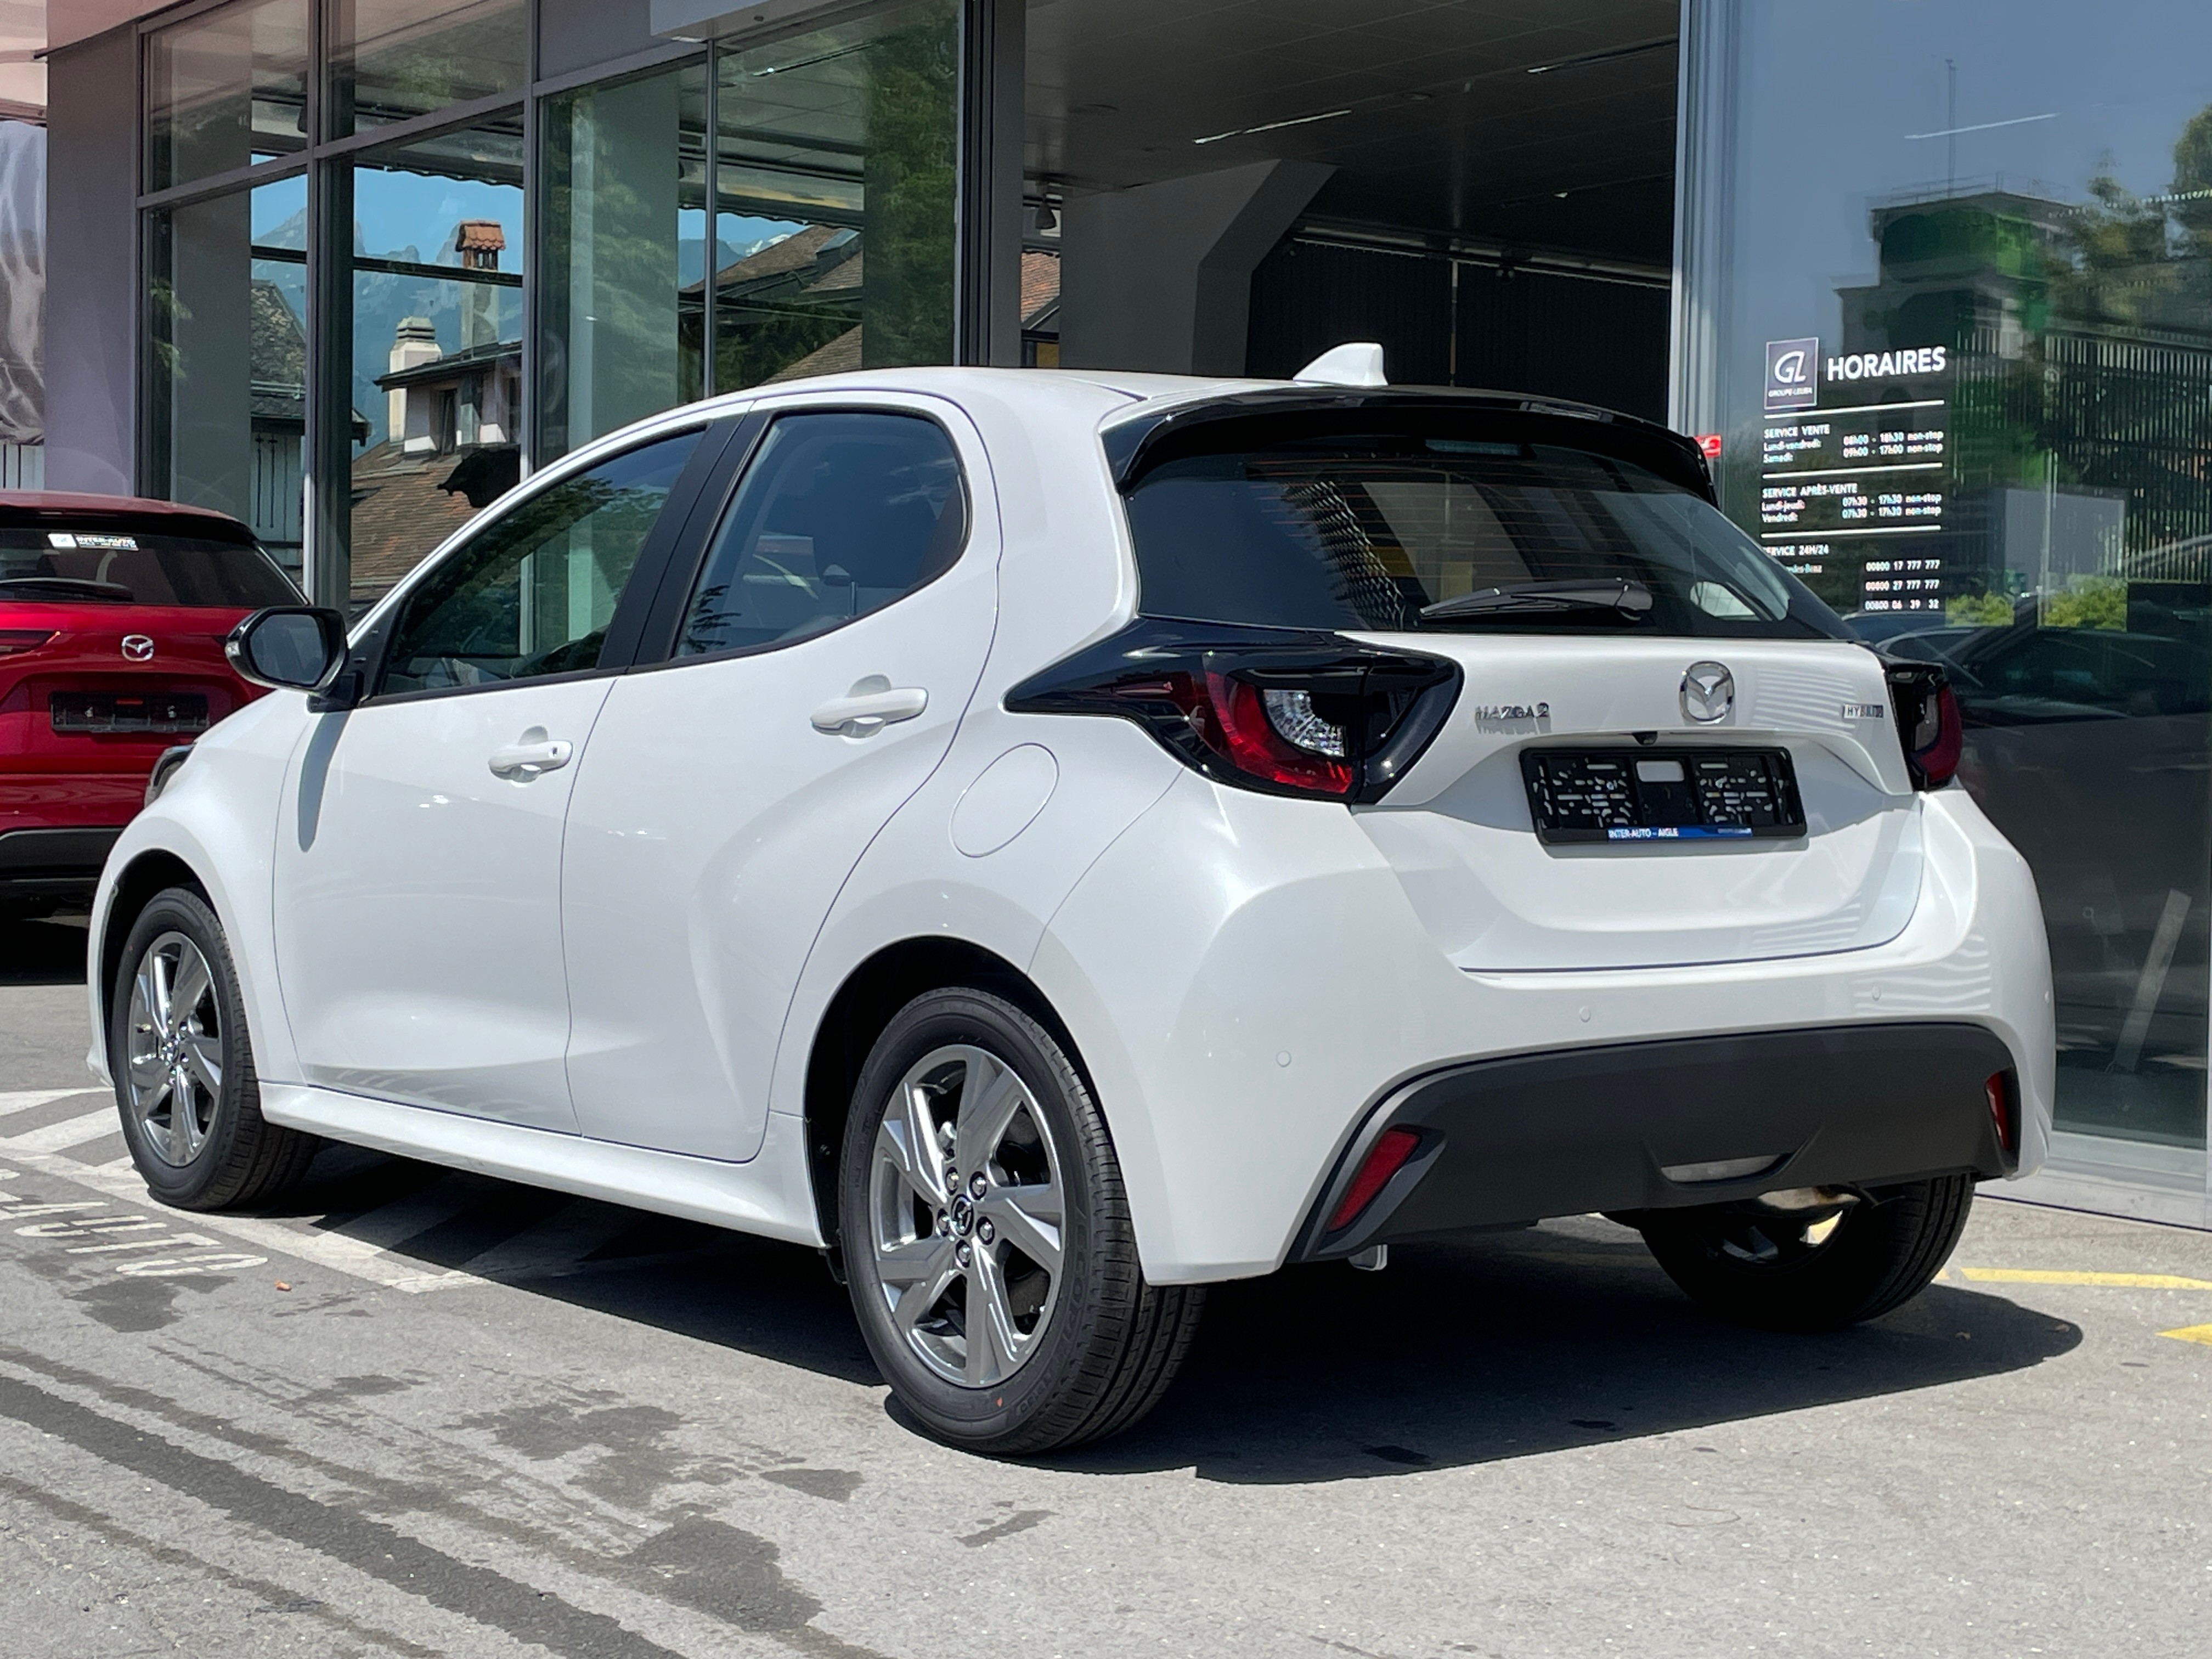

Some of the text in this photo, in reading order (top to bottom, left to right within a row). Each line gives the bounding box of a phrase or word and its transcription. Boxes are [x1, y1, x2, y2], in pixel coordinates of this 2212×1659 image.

[1828, 347, 1945, 381] HORAIRES
[1764, 425, 1830, 438] SERVICE VENTE
[1763, 483, 1857, 498] SERVICE APRÈS-VENTE
[1843, 496, 1867, 506] 07h30
[1878, 494, 1902, 504] 17h30
[1842, 508, 1867, 518] 07h30
[1879, 506, 1901, 516] 17h30
[1907, 561, 1921, 569] 777
[1926, 560, 1940, 569] 777
[1893, 580, 1903, 590] 27
[1907, 580, 1920, 589] 777
[1925, 580, 1939, 589] 777
